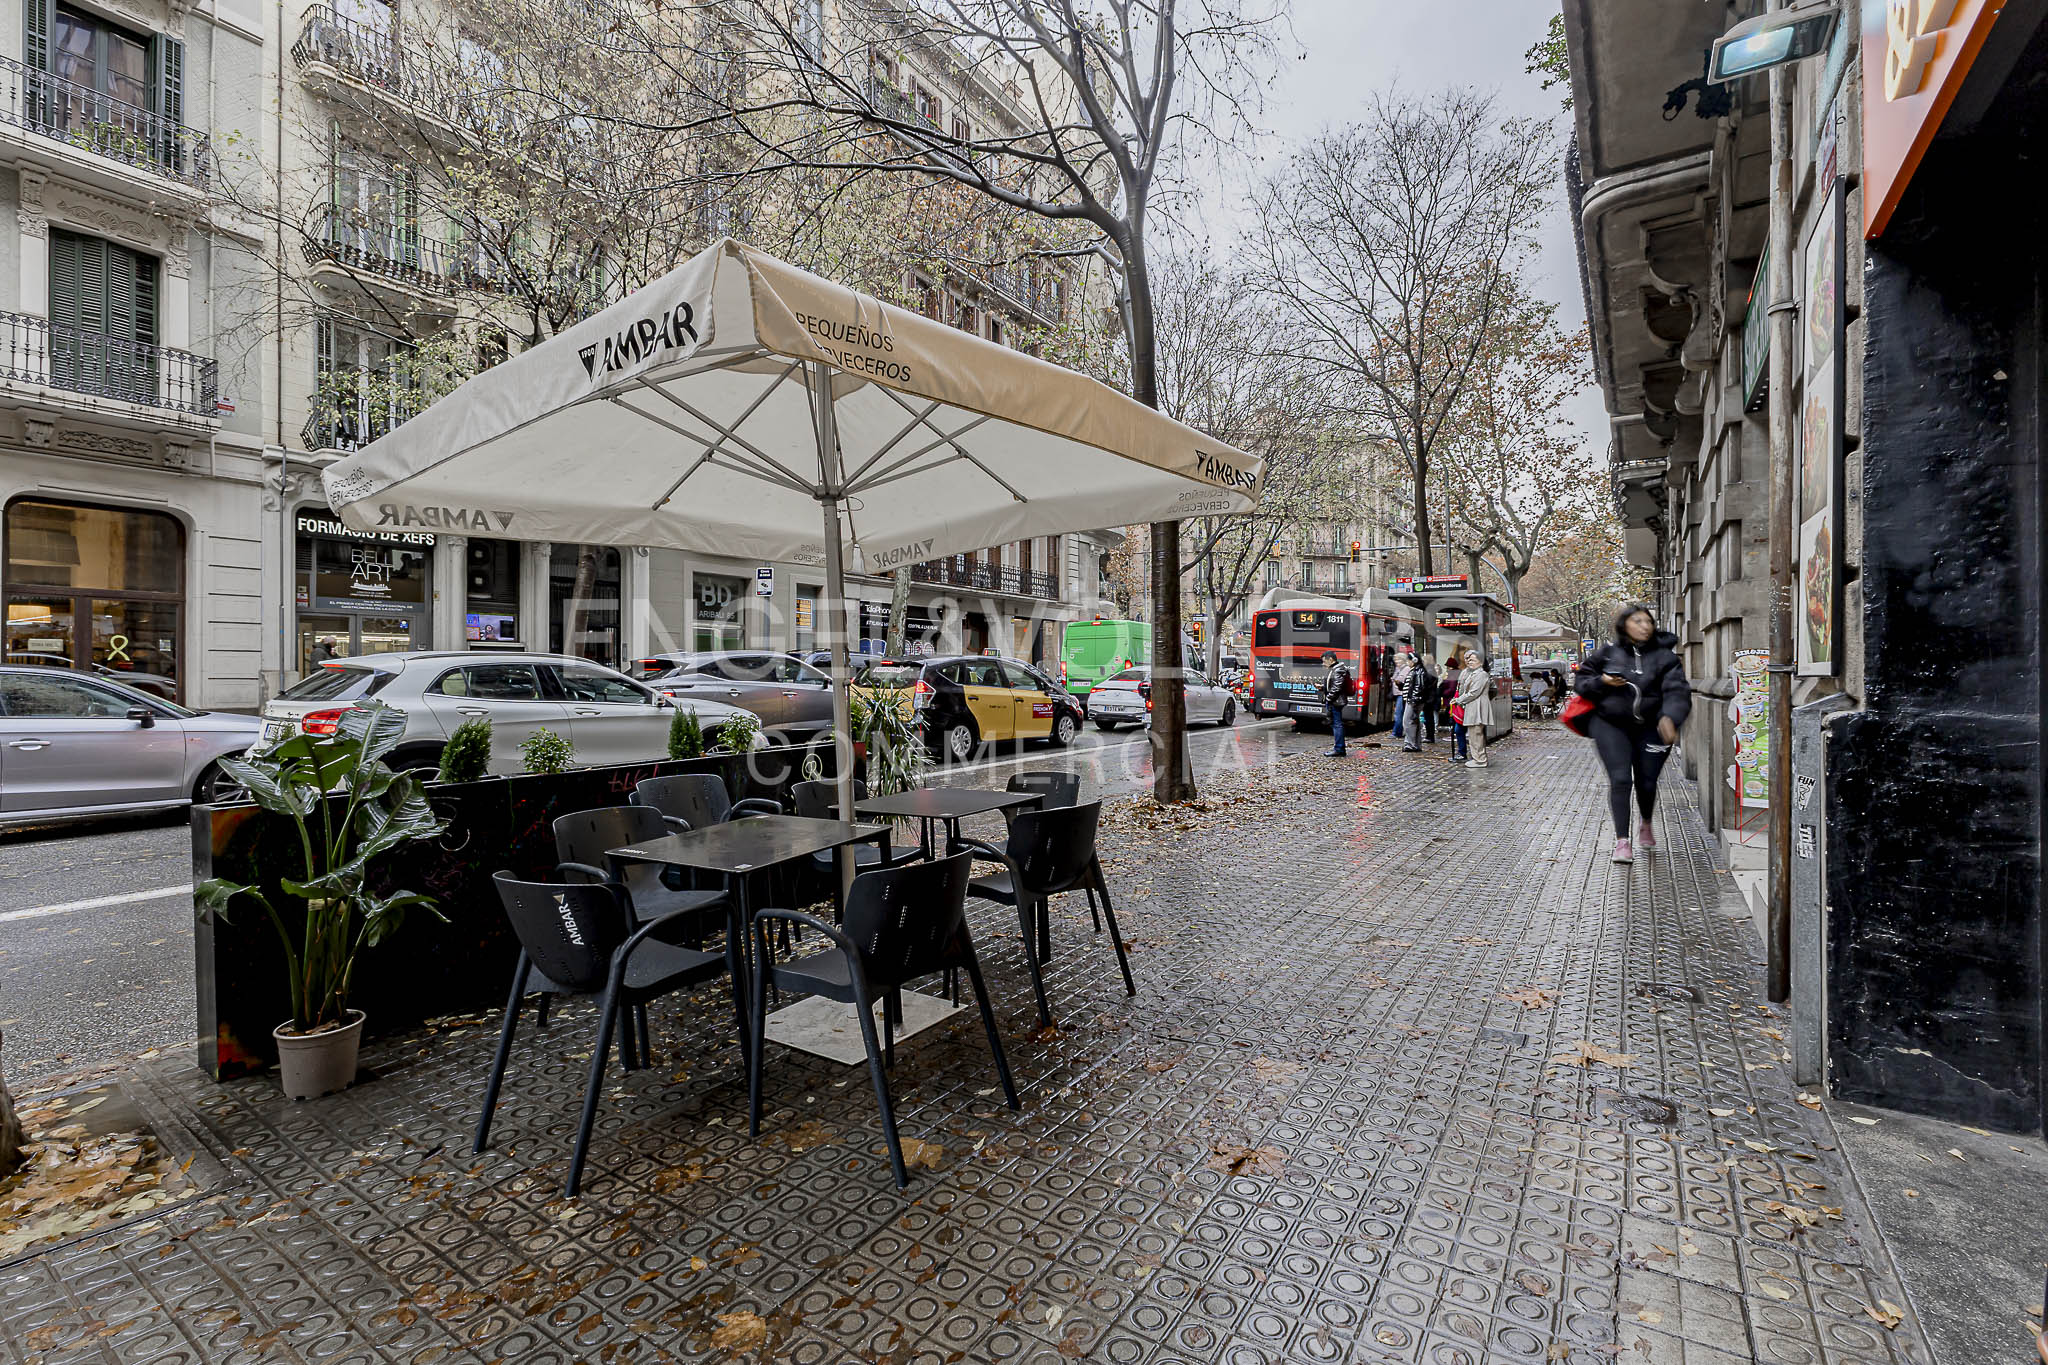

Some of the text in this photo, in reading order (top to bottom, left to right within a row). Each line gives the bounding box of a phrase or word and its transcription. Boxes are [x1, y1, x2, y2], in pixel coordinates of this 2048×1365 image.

[598, 301, 698, 377] AMBAR
[581, 347, 595, 359] 1900
[813, 339, 911, 382] VECEROS
[1205, 456, 1256, 493] AMBAR
[380, 532, 399, 541] DE
[402, 532, 435, 546] XEFS
[351, 548, 393, 566] BELL
[350, 563, 393, 582] ART
[702, 582, 732, 607] BD
[1300, 613, 1313, 623] 54
[1326, 615, 1344, 624] 1811
[1273, 681, 1292, 690] VEUS
[558, 903, 585, 945] AMBAR
